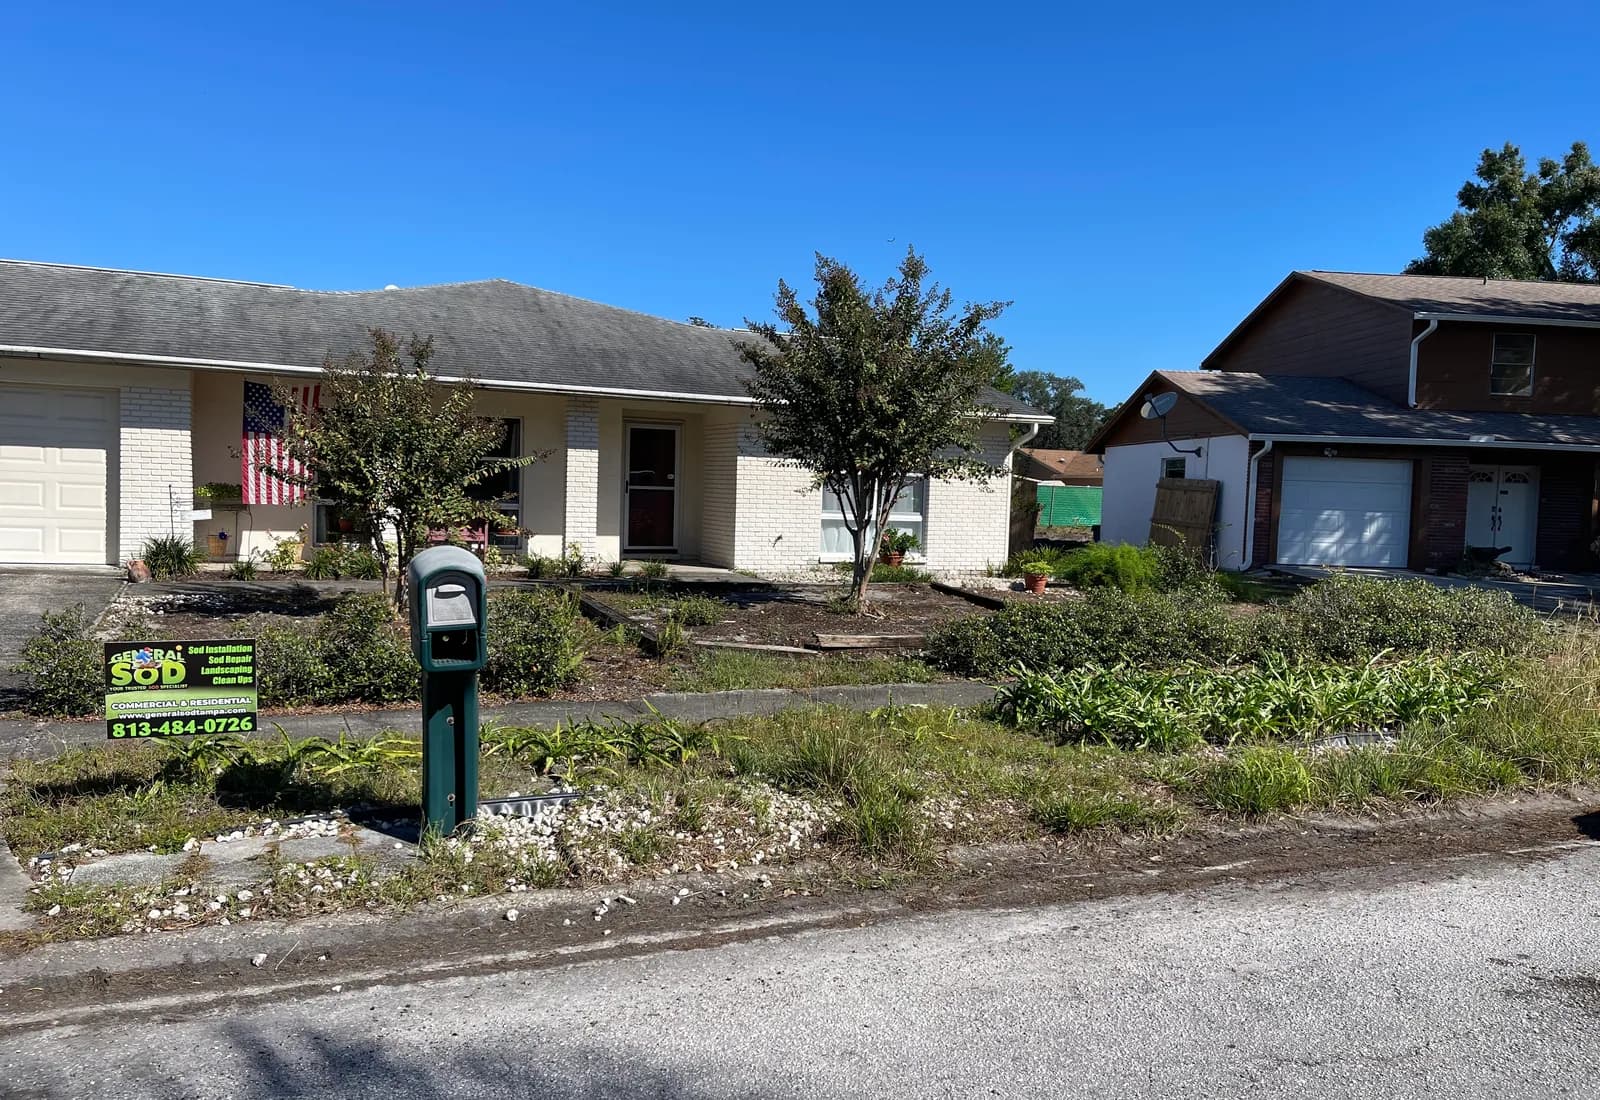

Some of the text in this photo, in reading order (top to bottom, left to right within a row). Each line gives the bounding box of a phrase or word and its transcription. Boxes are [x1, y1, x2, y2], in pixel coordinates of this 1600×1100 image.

[188, 645, 253, 654] Sod Installation
[110, 648, 185, 663] GENRAL
[208, 655, 253, 664] Sod Repair
[111, 659, 186, 686] SOD
[201, 665, 253, 675] Landscaping
[212, 675, 253, 685] Clean Ups
[111, 700, 178, 710] COMMERCIAL
[190, 697, 252, 706] RESIDENTIAL
[118, 708, 247, 719] www.generalsodtampa.com
[112, 716, 253, 738] 813-484-0726
